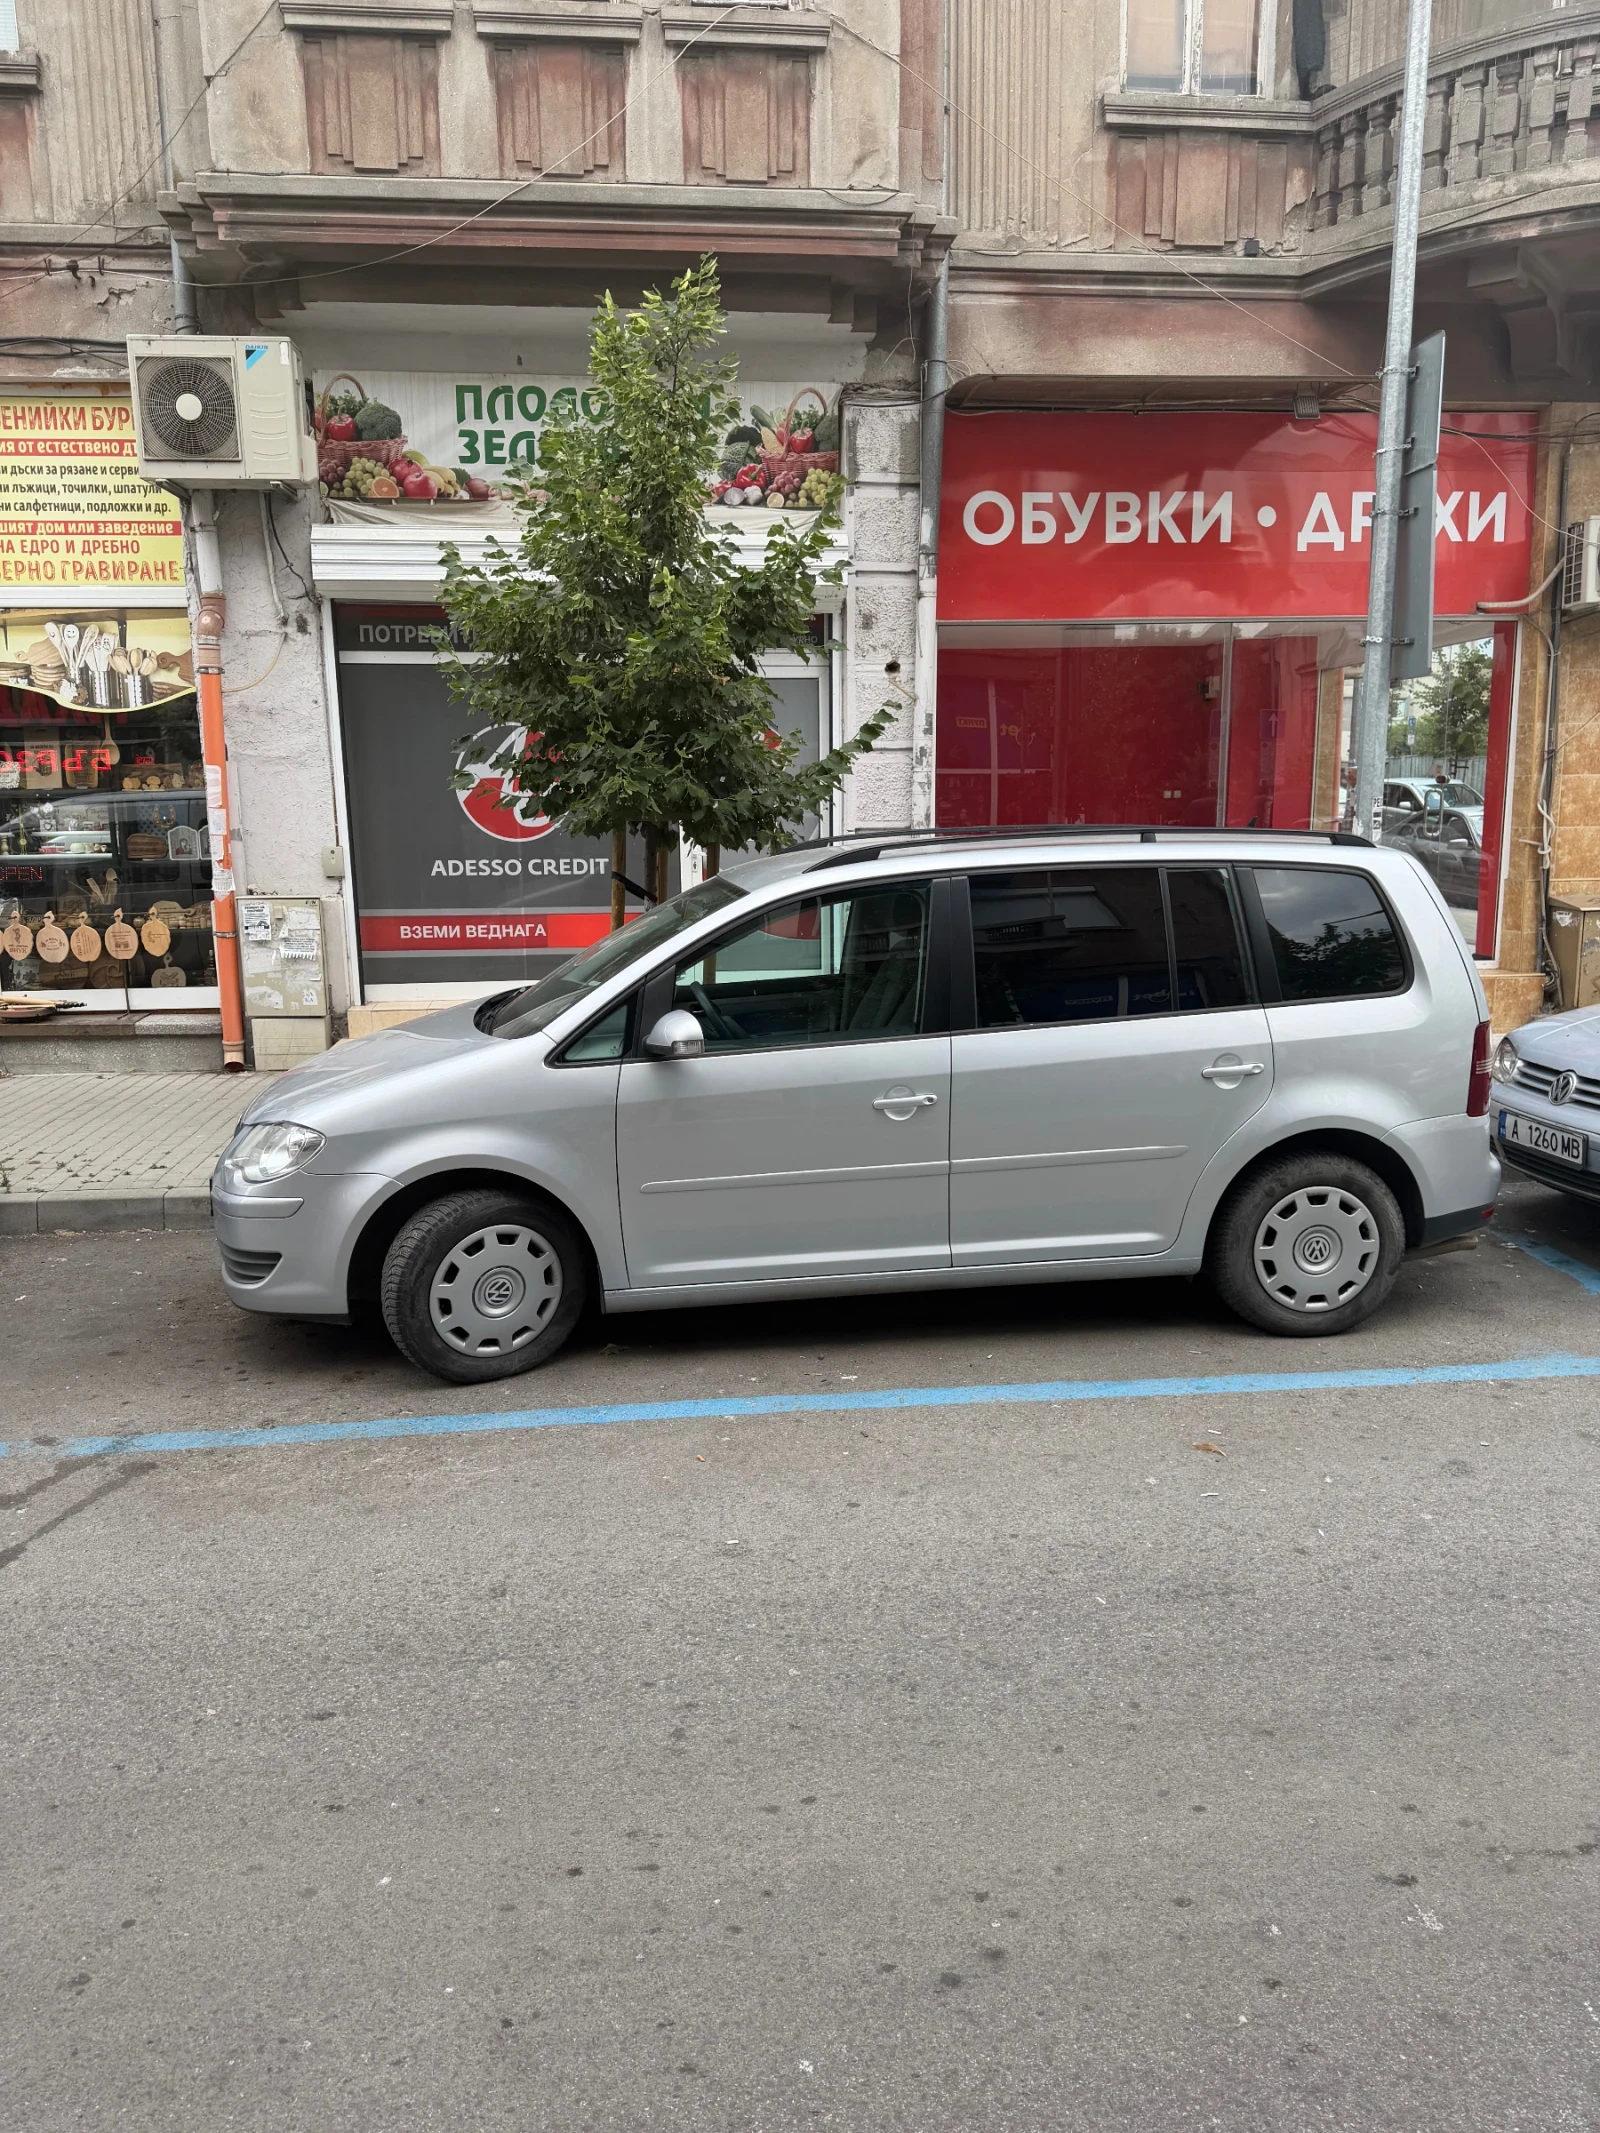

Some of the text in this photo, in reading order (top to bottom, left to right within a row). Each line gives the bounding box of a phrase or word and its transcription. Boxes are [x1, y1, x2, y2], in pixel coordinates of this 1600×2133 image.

[455, 384, 613, 424] ПЛОДО
[0, 401, 136, 431] ЕНИЙКИ БУР
[18, 441, 34, 454] от
[37, 441, 120, 454] естествено
[10, 465, 44, 477] дъски
[45, 465, 58, 475] за
[60, 465, 98, 480] рязане
[100, 465, 107, 475] и
[109, 465, 140, 480] серви
[12, 483, 60, 496] лъжици,
[62, 483, 112, 496] точилки,
[14, 499, 85, 515] салфетници,
[87, 502, 143, 514] подложки
[145, 502, 152, 512] и
[154, 502, 172, 516] др.
[36, 522, 65, 535] дом
[68, 522, 95, 533] или
[98, 522, 174, 535] заведение
[962, 489, 1508, 552] ОБУВКИ ДРХИ
[20, 540, 60, 556] ЕДРО
[66, 540, 75, 554] И
[81, 540, 141, 556] ДРЕБНО
[0, 560, 180, 582] ЕРНО ГРАВИРАНЕ
[431, 858, 610, 876] ADESSO CREDIT
[400, 924, 547, 940] ВЗЕМИ ВЕДНАГА
[1511, 1119, 1580, 1160] A 1260 MB
